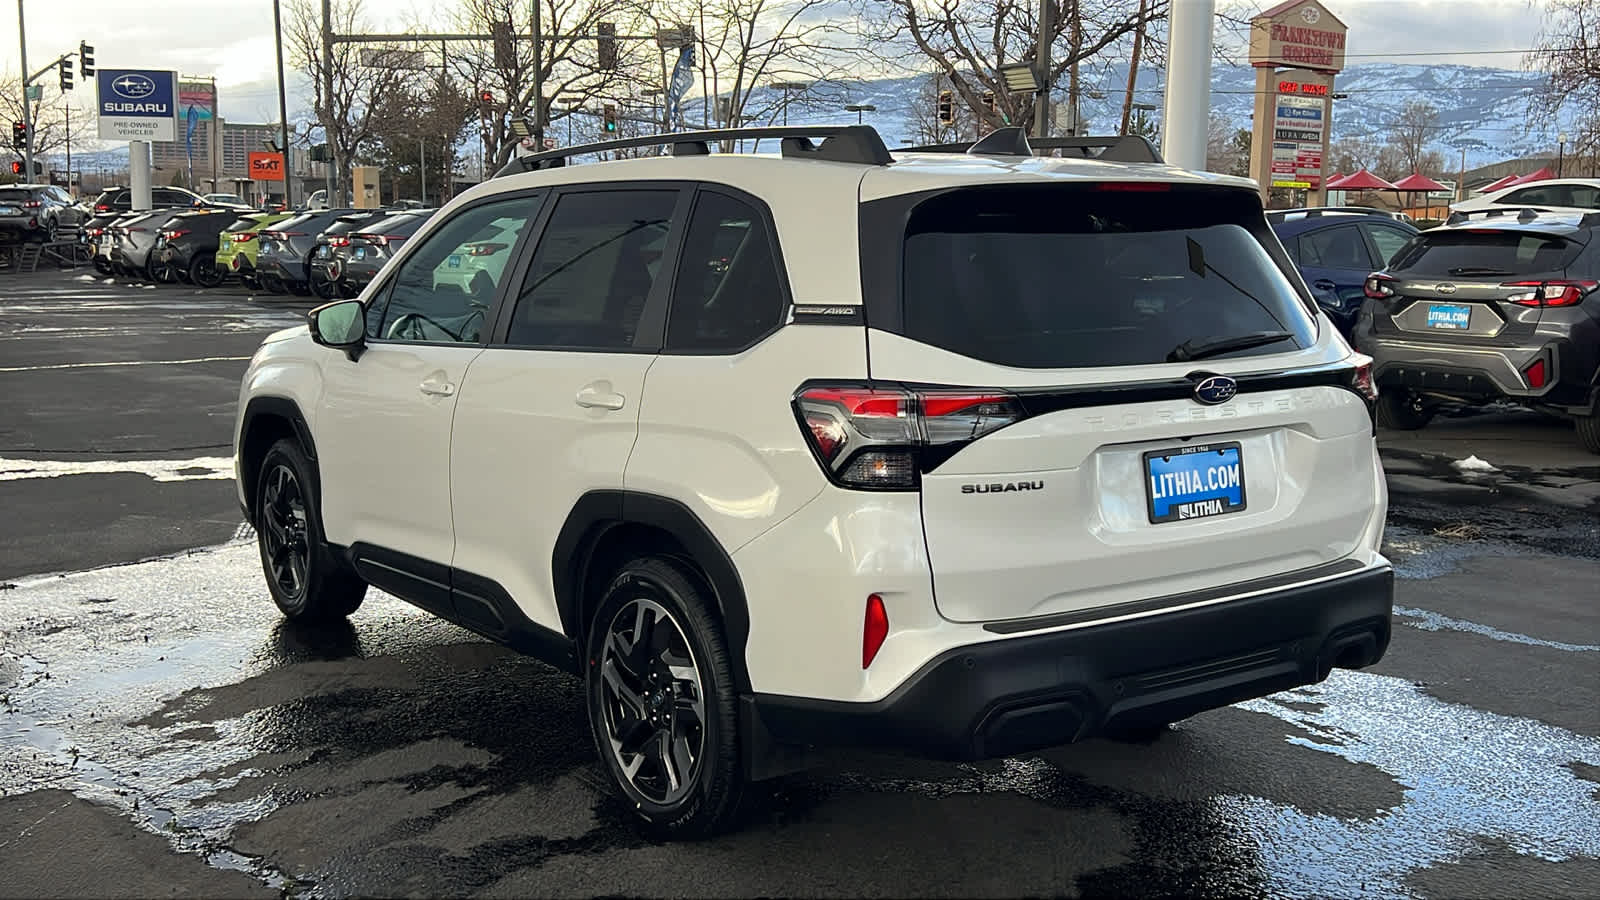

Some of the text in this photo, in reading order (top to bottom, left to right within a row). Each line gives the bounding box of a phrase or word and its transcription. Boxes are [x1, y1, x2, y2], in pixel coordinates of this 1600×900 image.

[1279, 81, 1328, 96] CAR WASH
[104, 103, 167, 113] SUBARU
[113, 121, 159, 129] PRE-OWNED
[823, 306, 856, 315] AWD
[1428, 311, 1469, 322] LITHIA.COM
[1082, 395, 1315, 425] FORESTER
[961, 481, 1044, 494] SUBARU
[1151, 463, 1241, 499] LITHIA.COM
[1189, 499, 1224, 518] LITHIA
